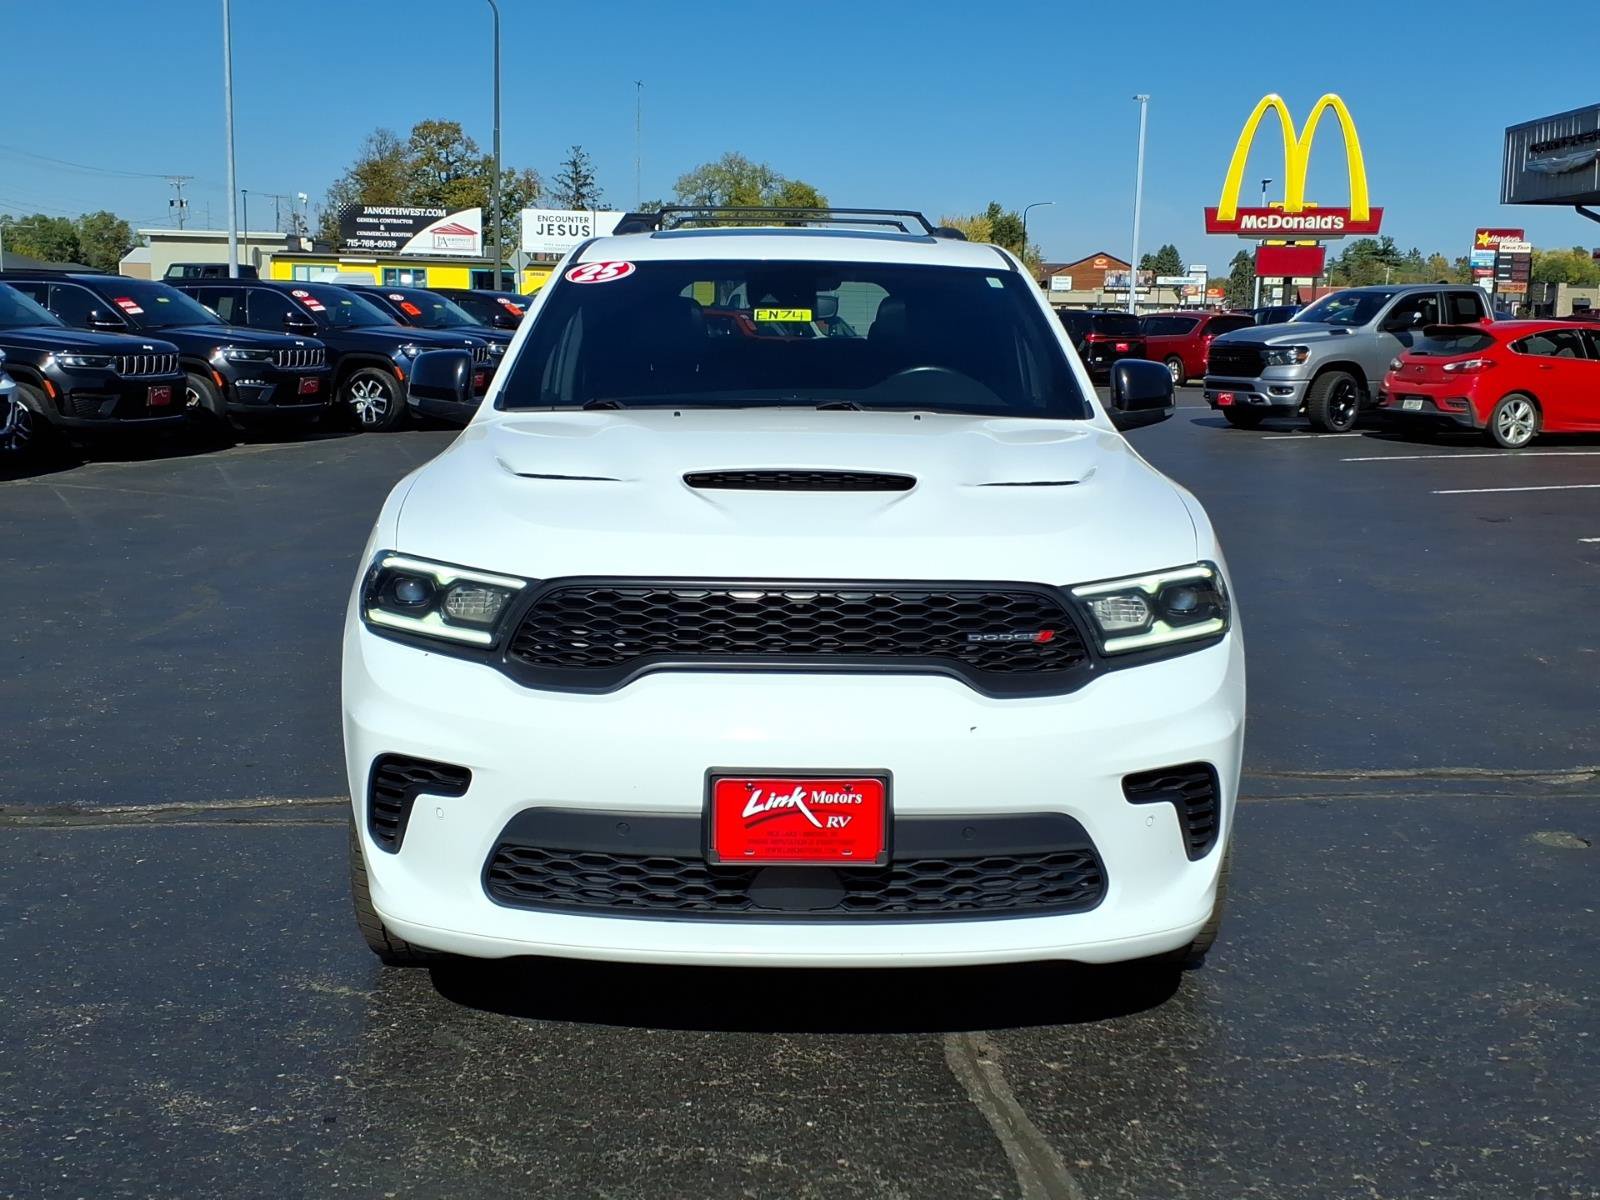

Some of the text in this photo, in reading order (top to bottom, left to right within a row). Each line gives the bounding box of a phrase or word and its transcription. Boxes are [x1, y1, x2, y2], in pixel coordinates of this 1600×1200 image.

[363, 206, 447, 217] JANORTHWEST.COM
[537, 215, 590, 224] ENCOUNTER
[1240, 214, 1344, 230] McDonald's
[536, 223, 591, 237] JESUS
[346, 239, 397, 249] 715-768-6039
[573, 263, 625, 281] 25
[741, 786, 863, 829] Link Motors
[826, 816, 852, 829] RV
